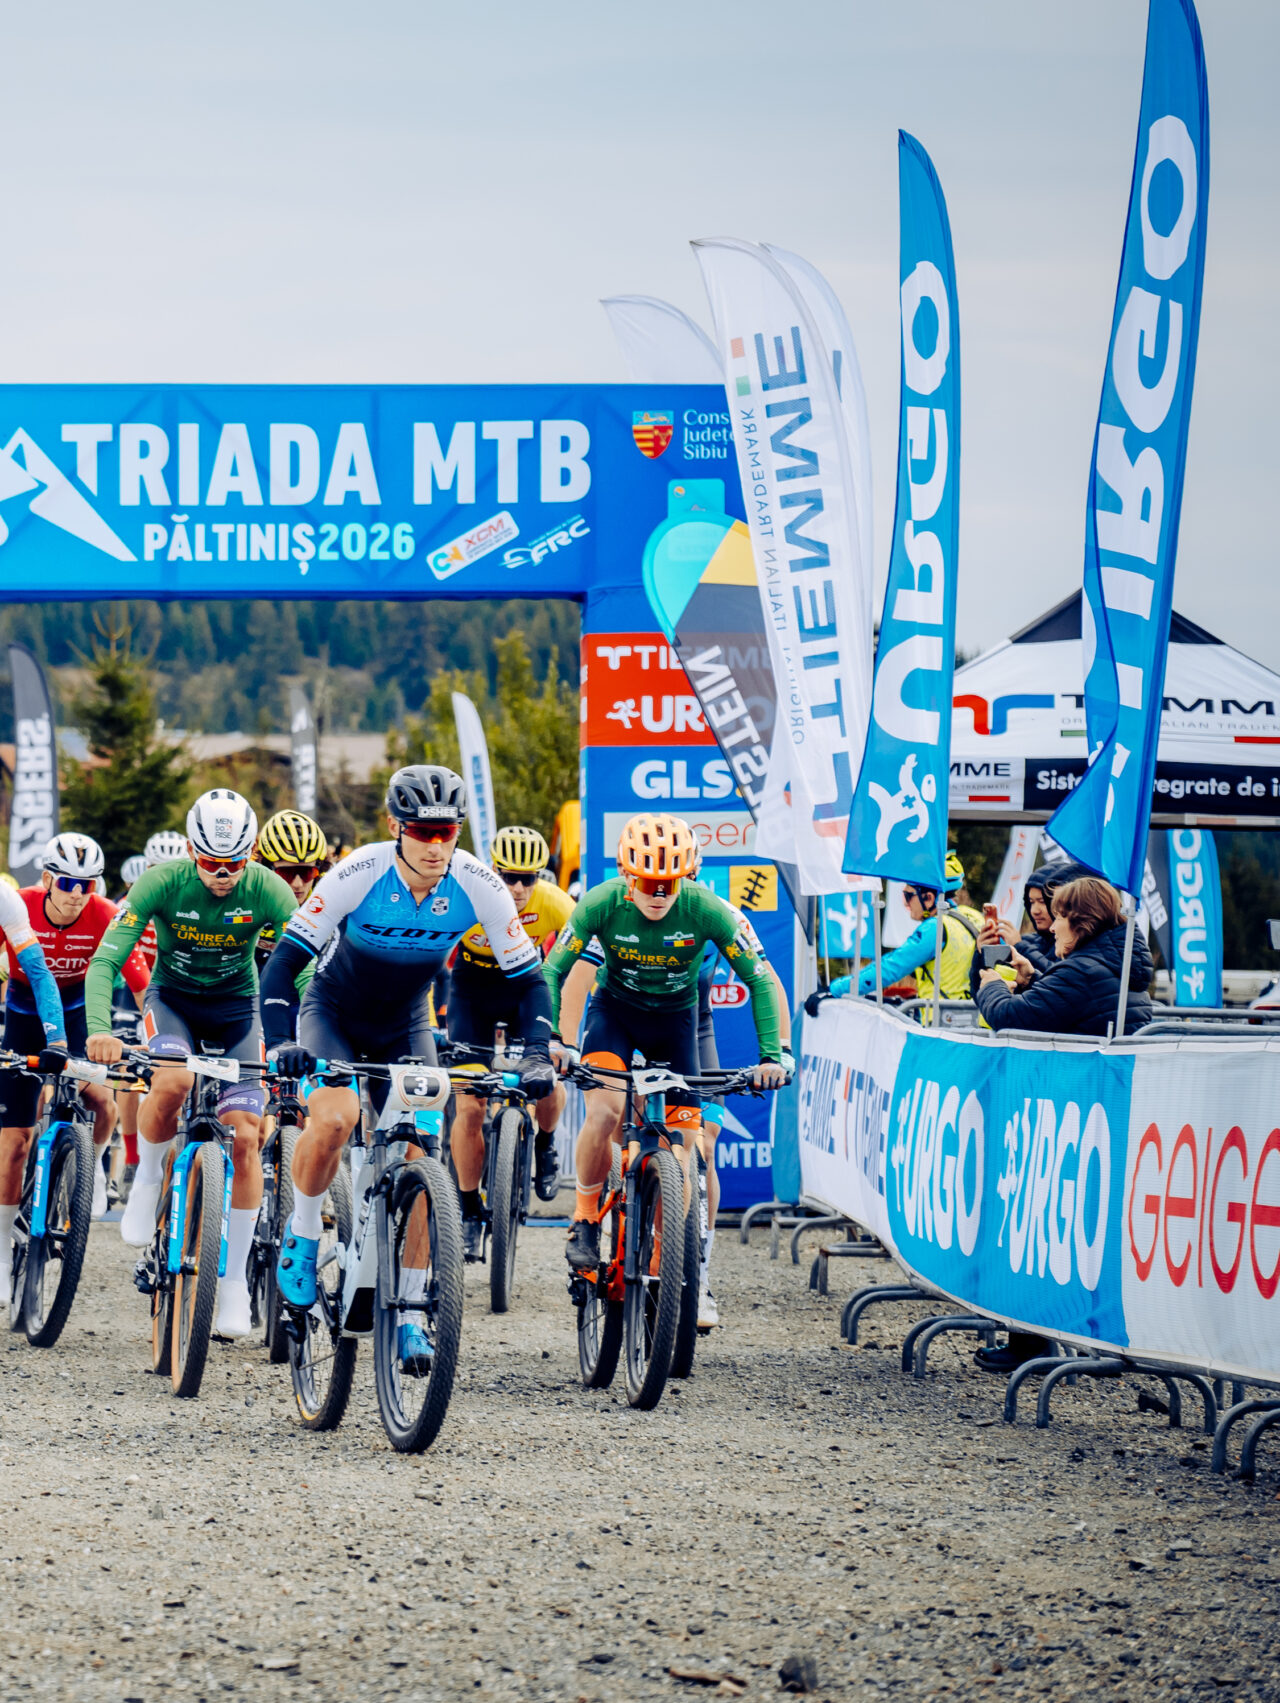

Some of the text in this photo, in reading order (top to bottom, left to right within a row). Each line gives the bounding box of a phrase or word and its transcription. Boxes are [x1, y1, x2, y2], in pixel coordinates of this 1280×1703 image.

[61, 420, 592, 506] TRIADA MTB
[683, 445, 728, 459] Sibiu
[465, 518, 505, 549] XCM
[1237, 775, 1266, 797] de
[177, 931, 236, 942] UNIREA
[358, 923, 464, 941] SCOTT
[618, 952, 679, 963] UNIREA
[413, 1076, 428, 1096] 3
[718, 1141, 773, 1169] MTB
[904, 1078, 984, 1257] URGO
[1008, 1098, 1111, 1292] URGO
